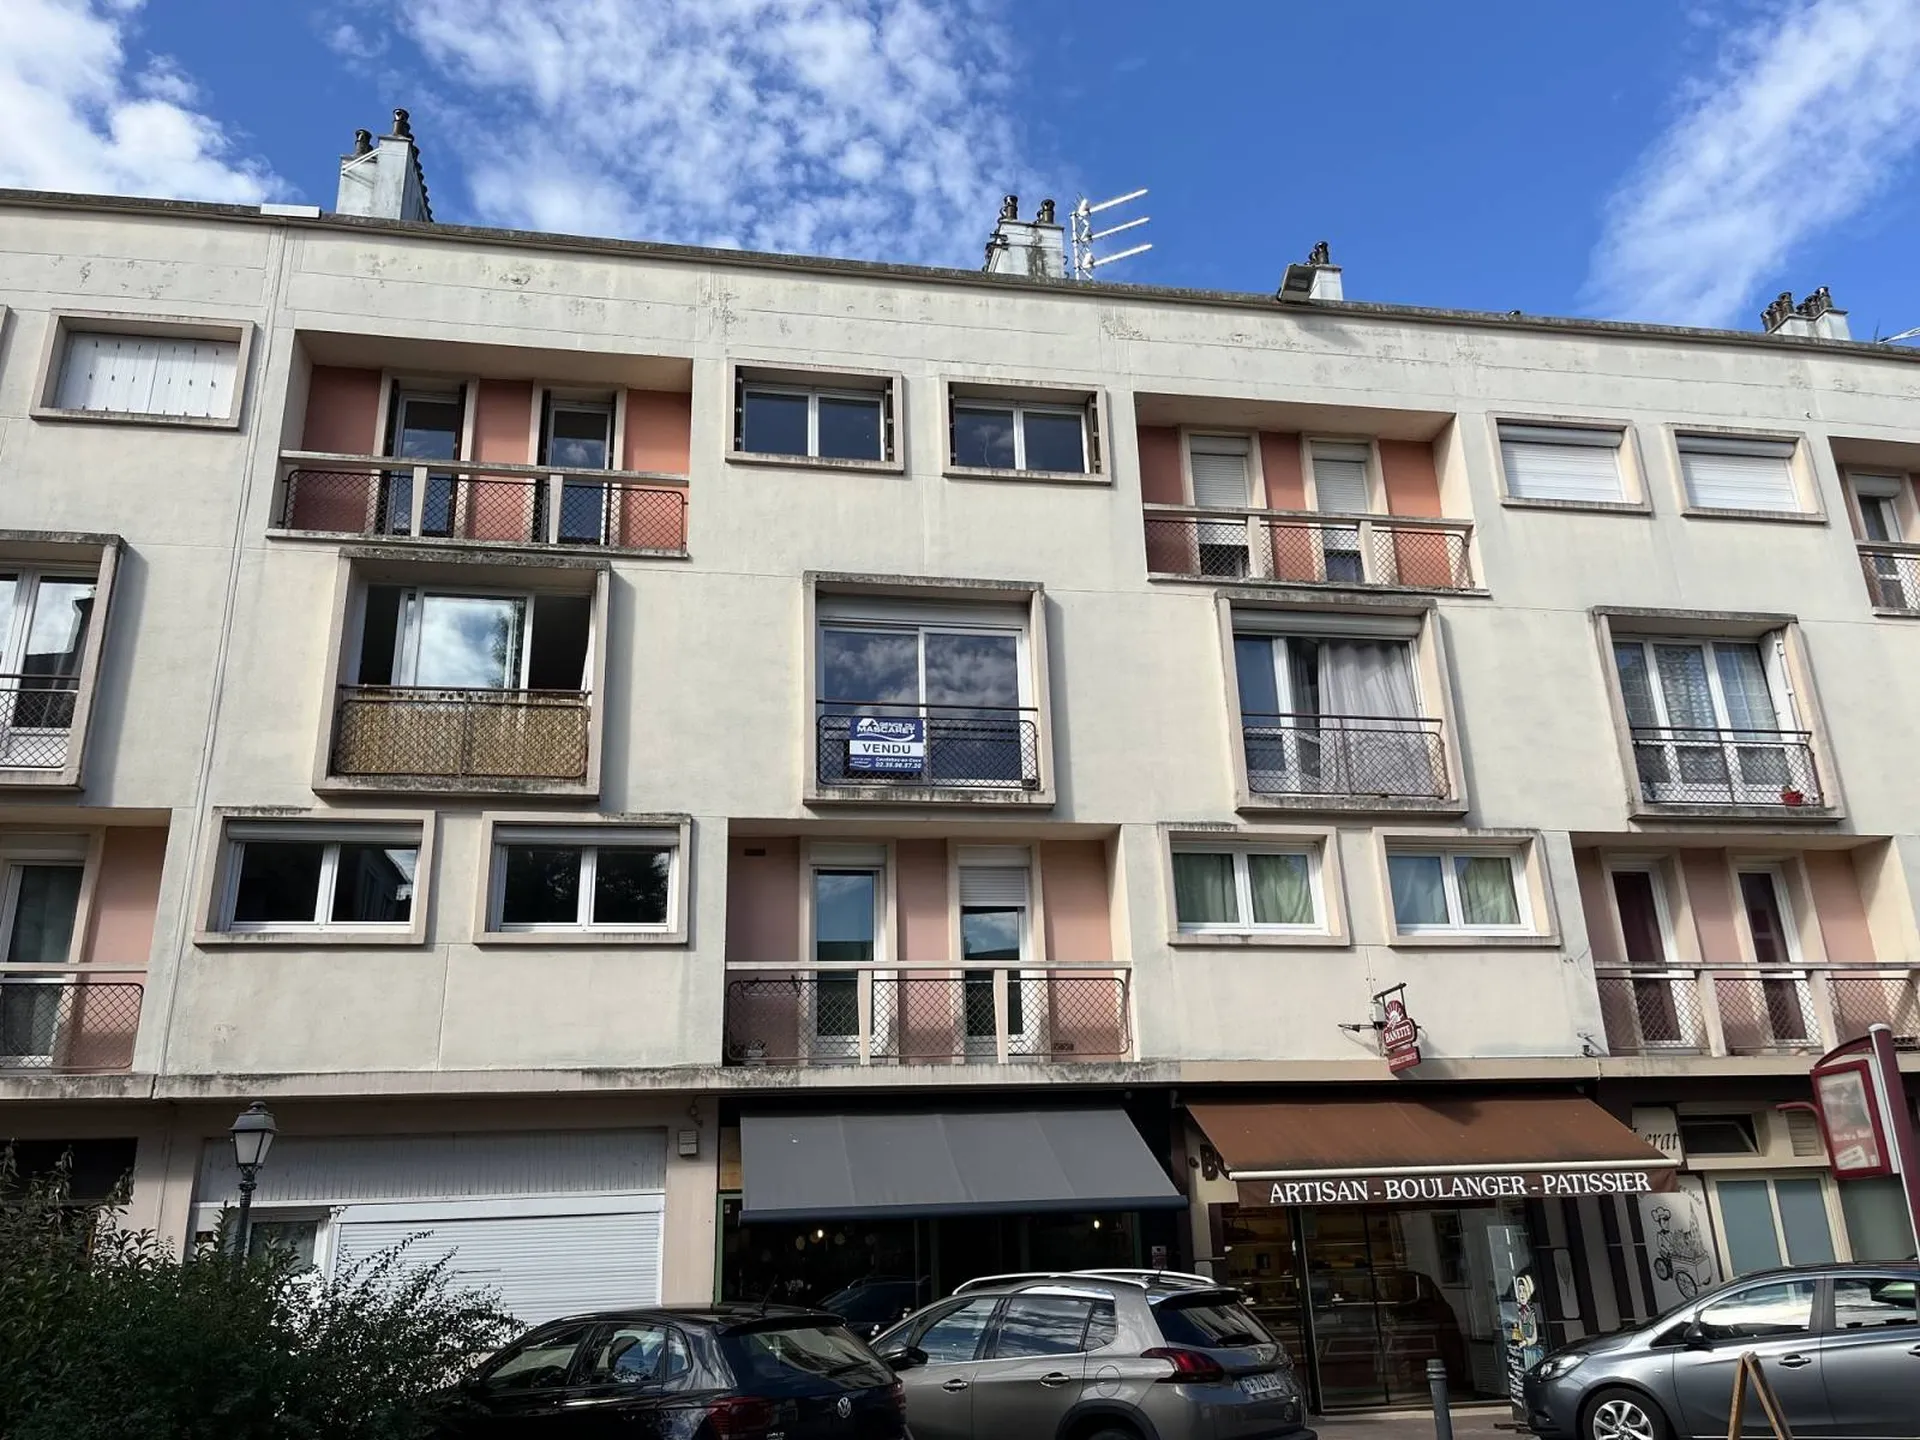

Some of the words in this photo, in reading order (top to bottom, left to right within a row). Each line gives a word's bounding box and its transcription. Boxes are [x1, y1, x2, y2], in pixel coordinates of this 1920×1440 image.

[863, 743, 911, 754] VENDU
[1270, 1180, 1369, 1203] ARTISAN
[1384, 1175, 1527, 1200] BOULANGER
[1541, 1172, 1652, 1194] PATISSIER
